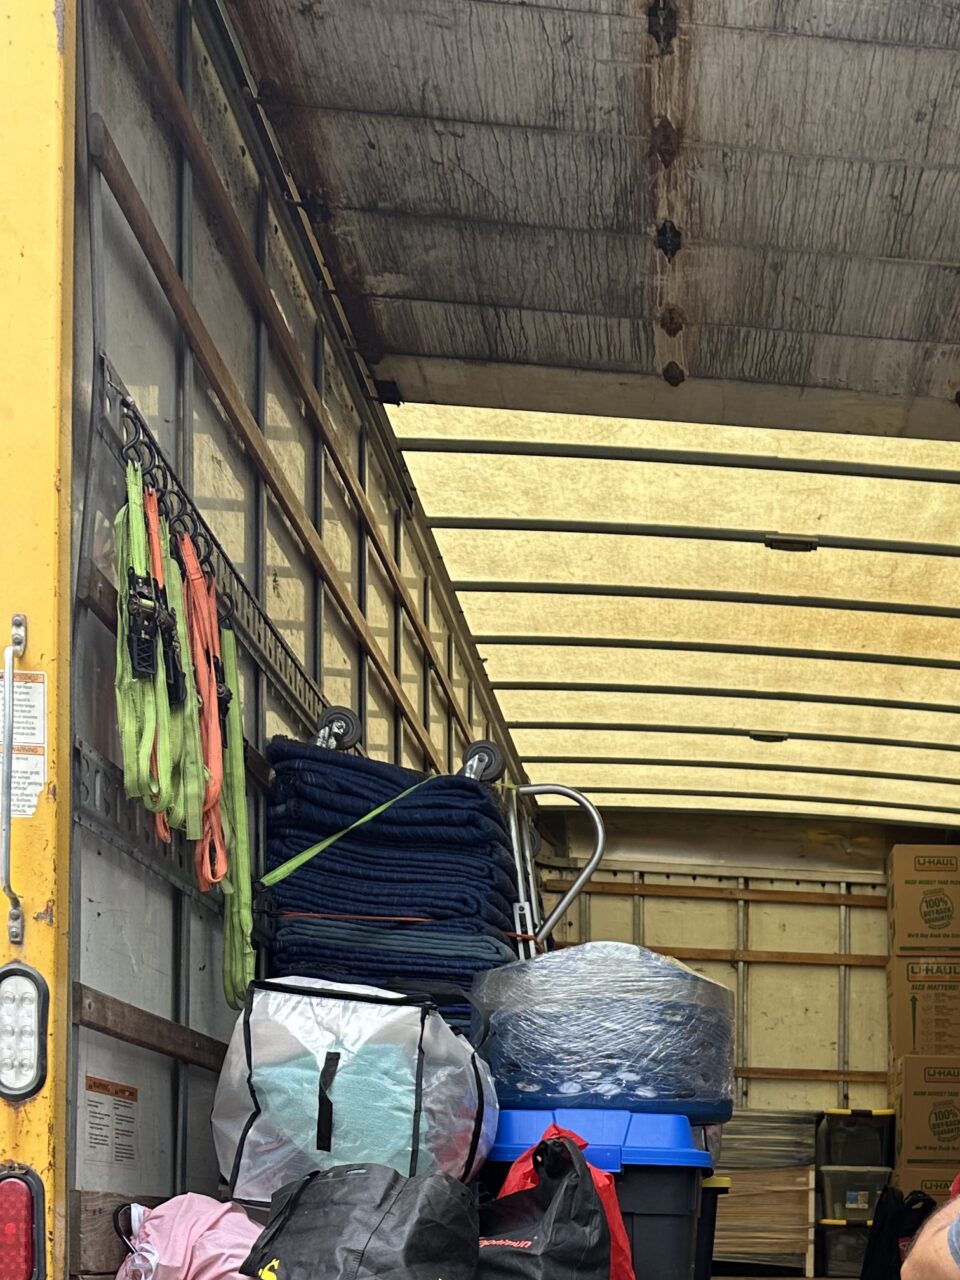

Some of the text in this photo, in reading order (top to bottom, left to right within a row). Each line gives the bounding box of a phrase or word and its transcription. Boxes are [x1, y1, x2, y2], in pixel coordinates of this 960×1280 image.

[917, 858, 955, 866] U-HAUL
[924, 897, 948, 910] 100%
[910, 965, 960, 976] U-HAUL
[933, 1107, 959, 1122] 100%
[924, 1182, 951, 1190] U-HA
